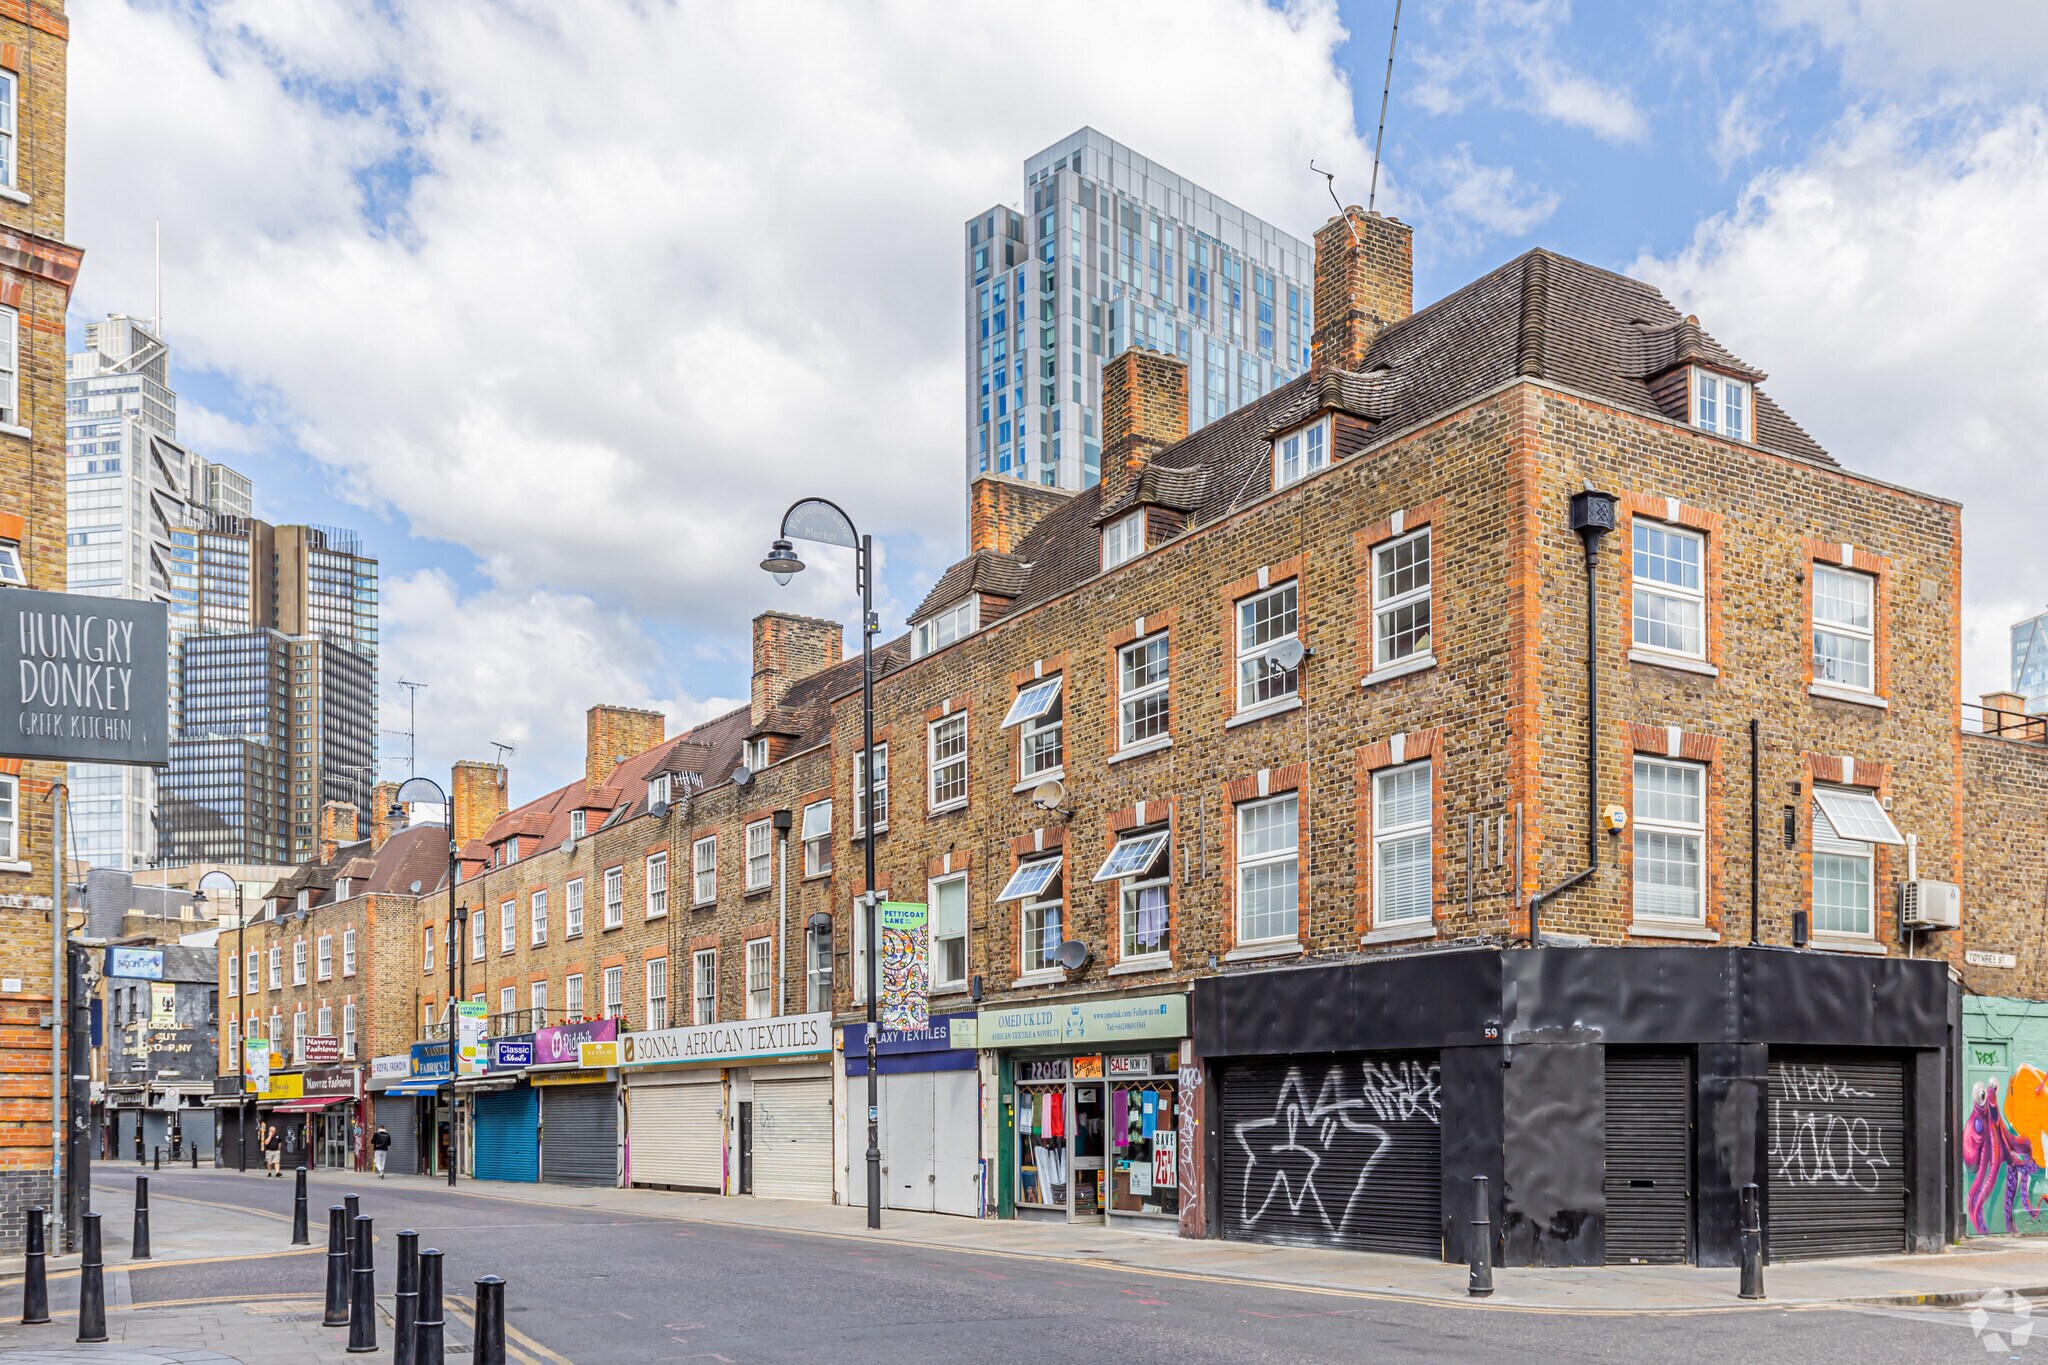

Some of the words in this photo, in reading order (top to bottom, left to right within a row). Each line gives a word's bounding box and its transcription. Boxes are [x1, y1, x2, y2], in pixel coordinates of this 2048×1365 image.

[19, 611, 134, 664] HUNGRY
[19, 659, 132, 711] DONKEY
[19, 711, 64, 738] GREEK
[71, 714, 132, 741] KITCHEN
[884, 910, 925, 919] PETTICOAT
[884, 917, 904, 925] LANE
[998, 1014, 1022, 1028] OMED
[1023, 1013, 1035, 1027] UK
[1036, 1011, 1053, 1026] LTD
[864, 1030, 899, 1045] GLAXY
[901, 1026, 947, 1042] TEXTILES
[992, 1032, 1012, 1041] AFRICAN
[1012, 1031, 1032, 1040] TEXTILE
[1036, 1029, 1060, 1038] NOVELTY
[1484, 1027, 1498, 1039] 59
[306, 1038, 337, 1046] Nawroz
[639, 1036, 679, 1060] SONNA
[685, 1028, 743, 1056] AFRICAN
[748, 1020, 818, 1050] TEXTILES
[306, 1044, 338, 1053] Fashions
[500, 1045, 530, 1054] Classic
[502, 1053, 527, 1062] Shoes
[1110, 1058, 1129, 1071] SALE
[1130, 1058, 1140, 1070] NOW
[306, 1078, 328, 1090] Nawroz
[328, 1075, 352, 1089] Fashions
[1155, 1132, 1174, 1146] SAVE
[1155, 1149, 1175, 1186] 25%
